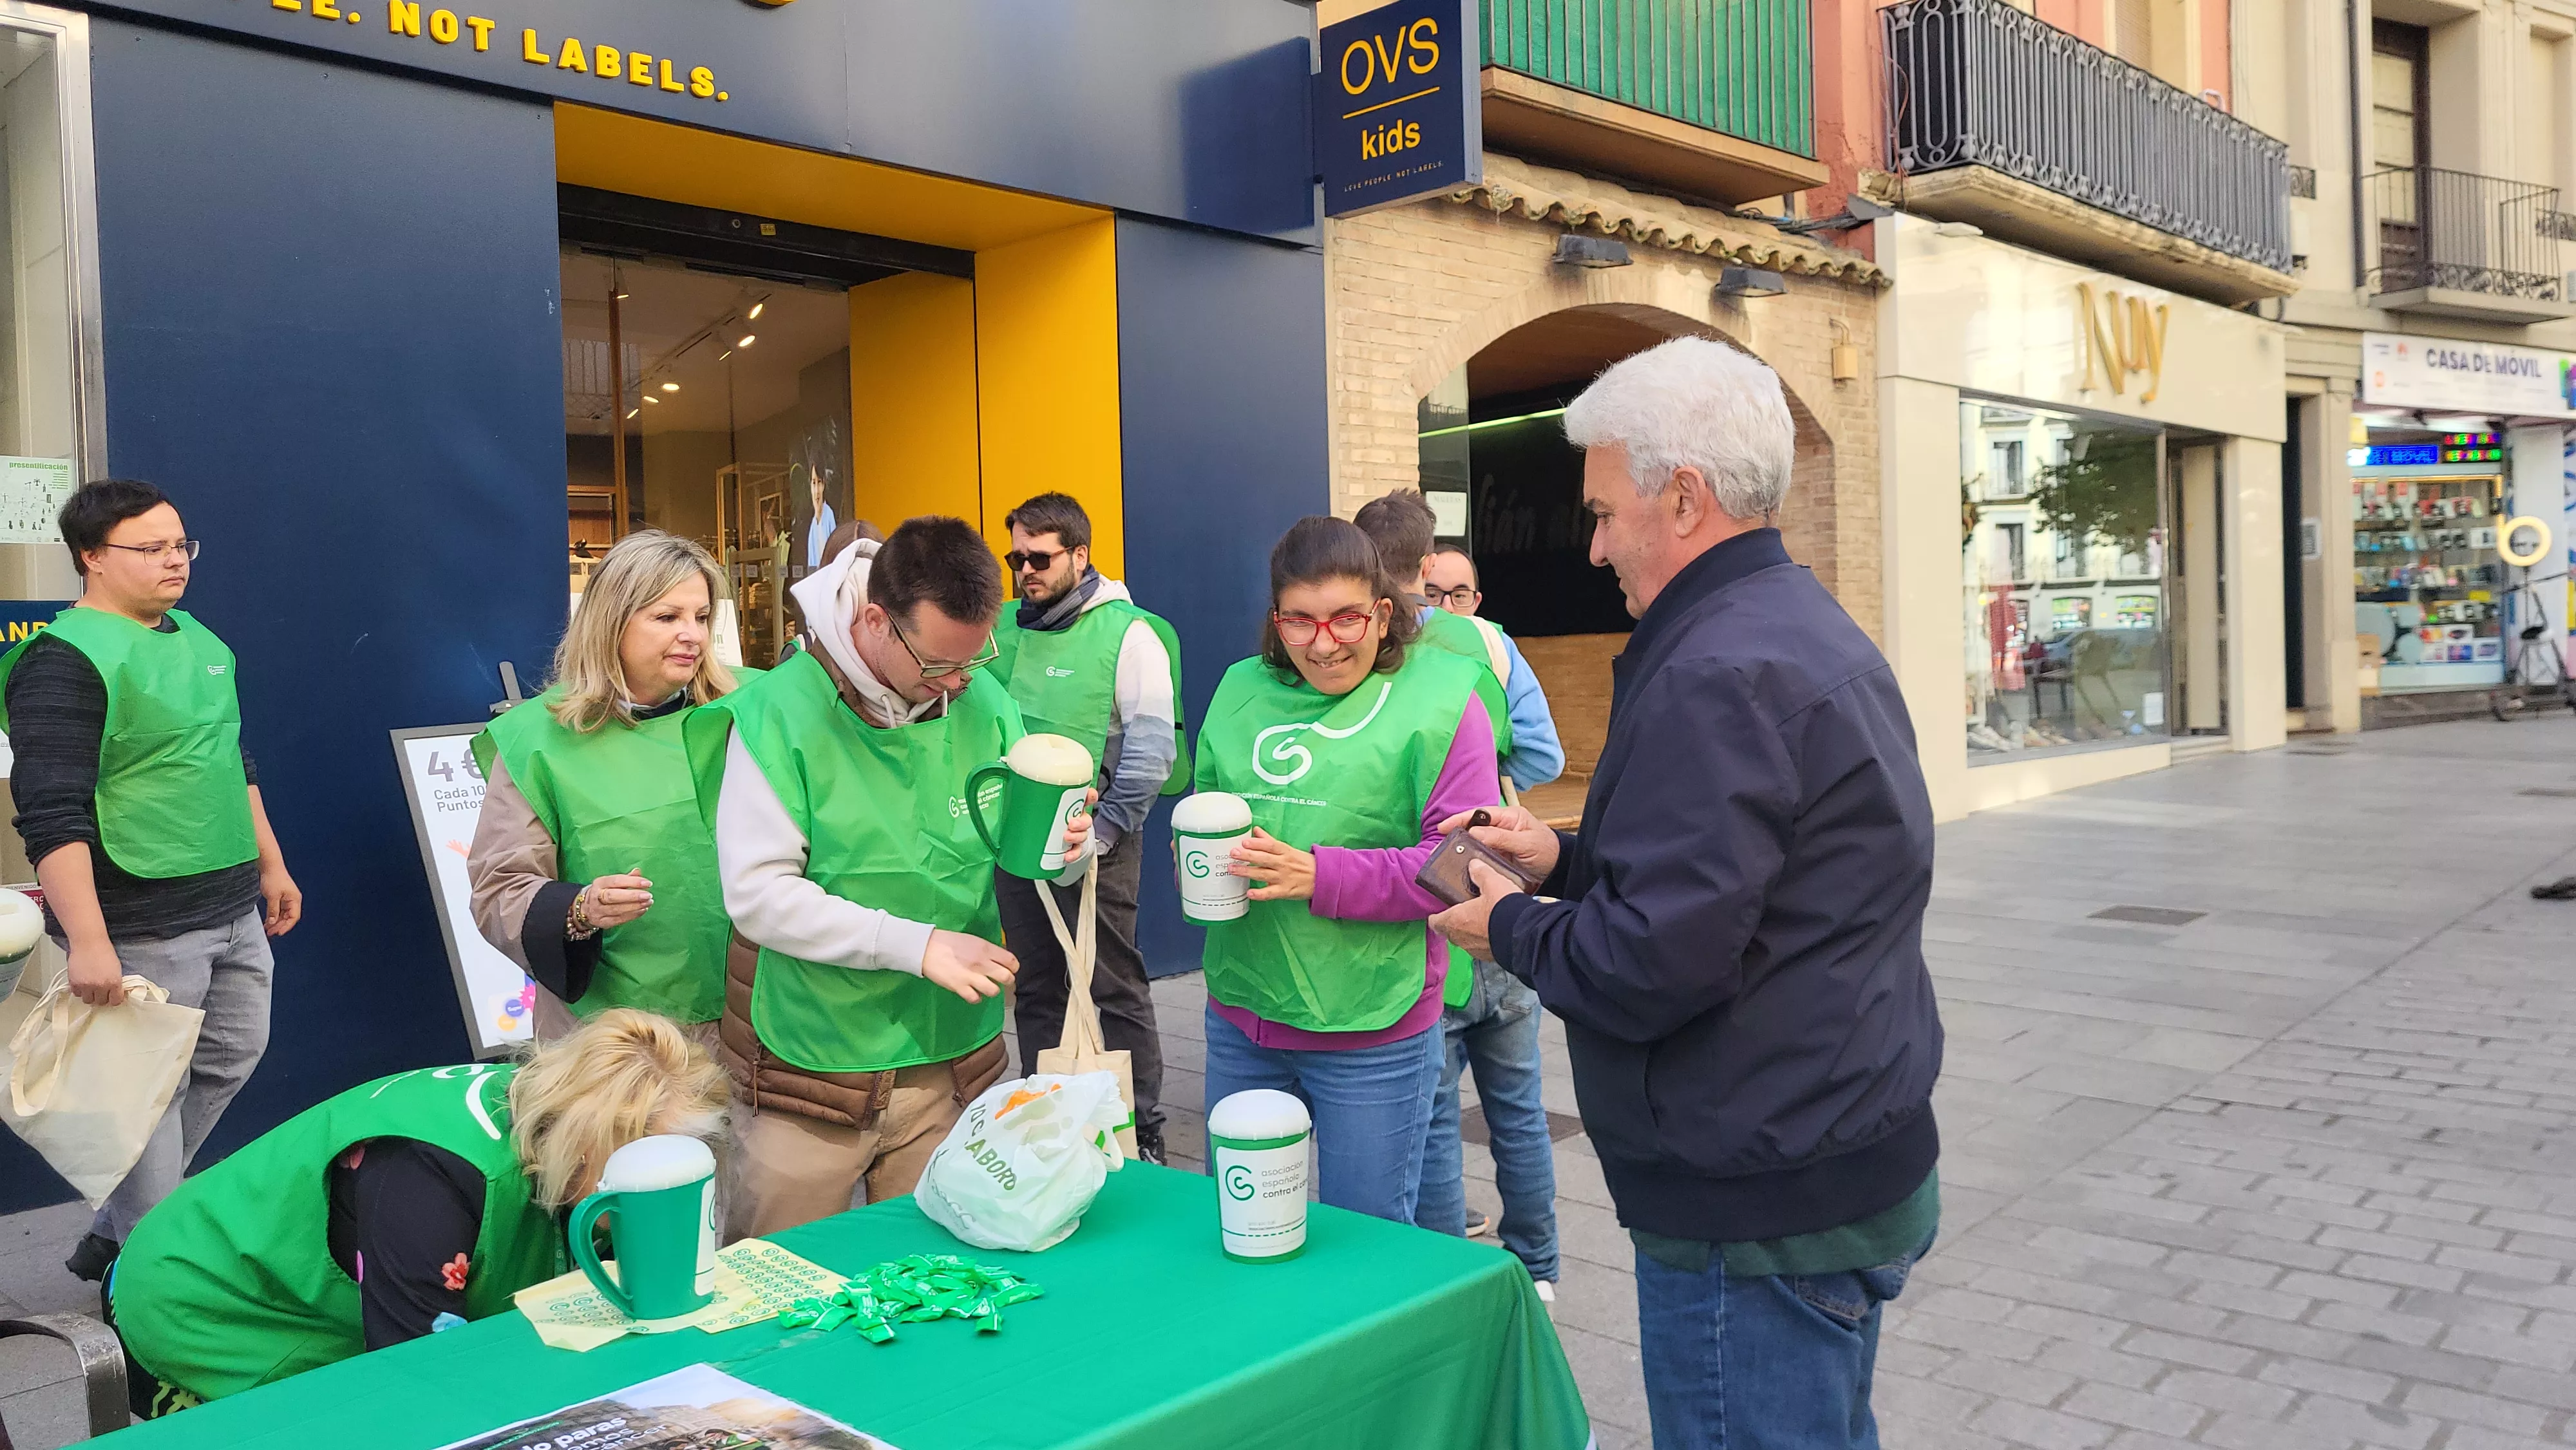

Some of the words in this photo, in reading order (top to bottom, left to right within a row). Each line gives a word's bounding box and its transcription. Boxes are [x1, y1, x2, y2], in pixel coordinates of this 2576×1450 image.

[388, 0, 496, 53] NOT
[522, 28, 730, 102] LABELS.
[1341, 17, 1440, 95] OVS
[1361, 118, 1421, 161] kids
[1364, 173, 1392, 187] PEOPLE
[1396, 168, 1410, 178] NOT
[2426, 348, 2470, 372] CASA
[2473, 353, 2492, 373] DE
[2495, 350, 2543, 378] MÓVIL
[428, 751, 454, 782] 4
[433, 787, 469, 800] Cada
[437, 800, 484, 813] Puntos
[1262, 1160, 1303, 1176] asociación
[1262, 1172, 1300, 1189] española
[1263, 1188, 1291, 1198] contra
[1293, 1182, 1298, 1191] el
[554, 1417, 627, 1448] paras
